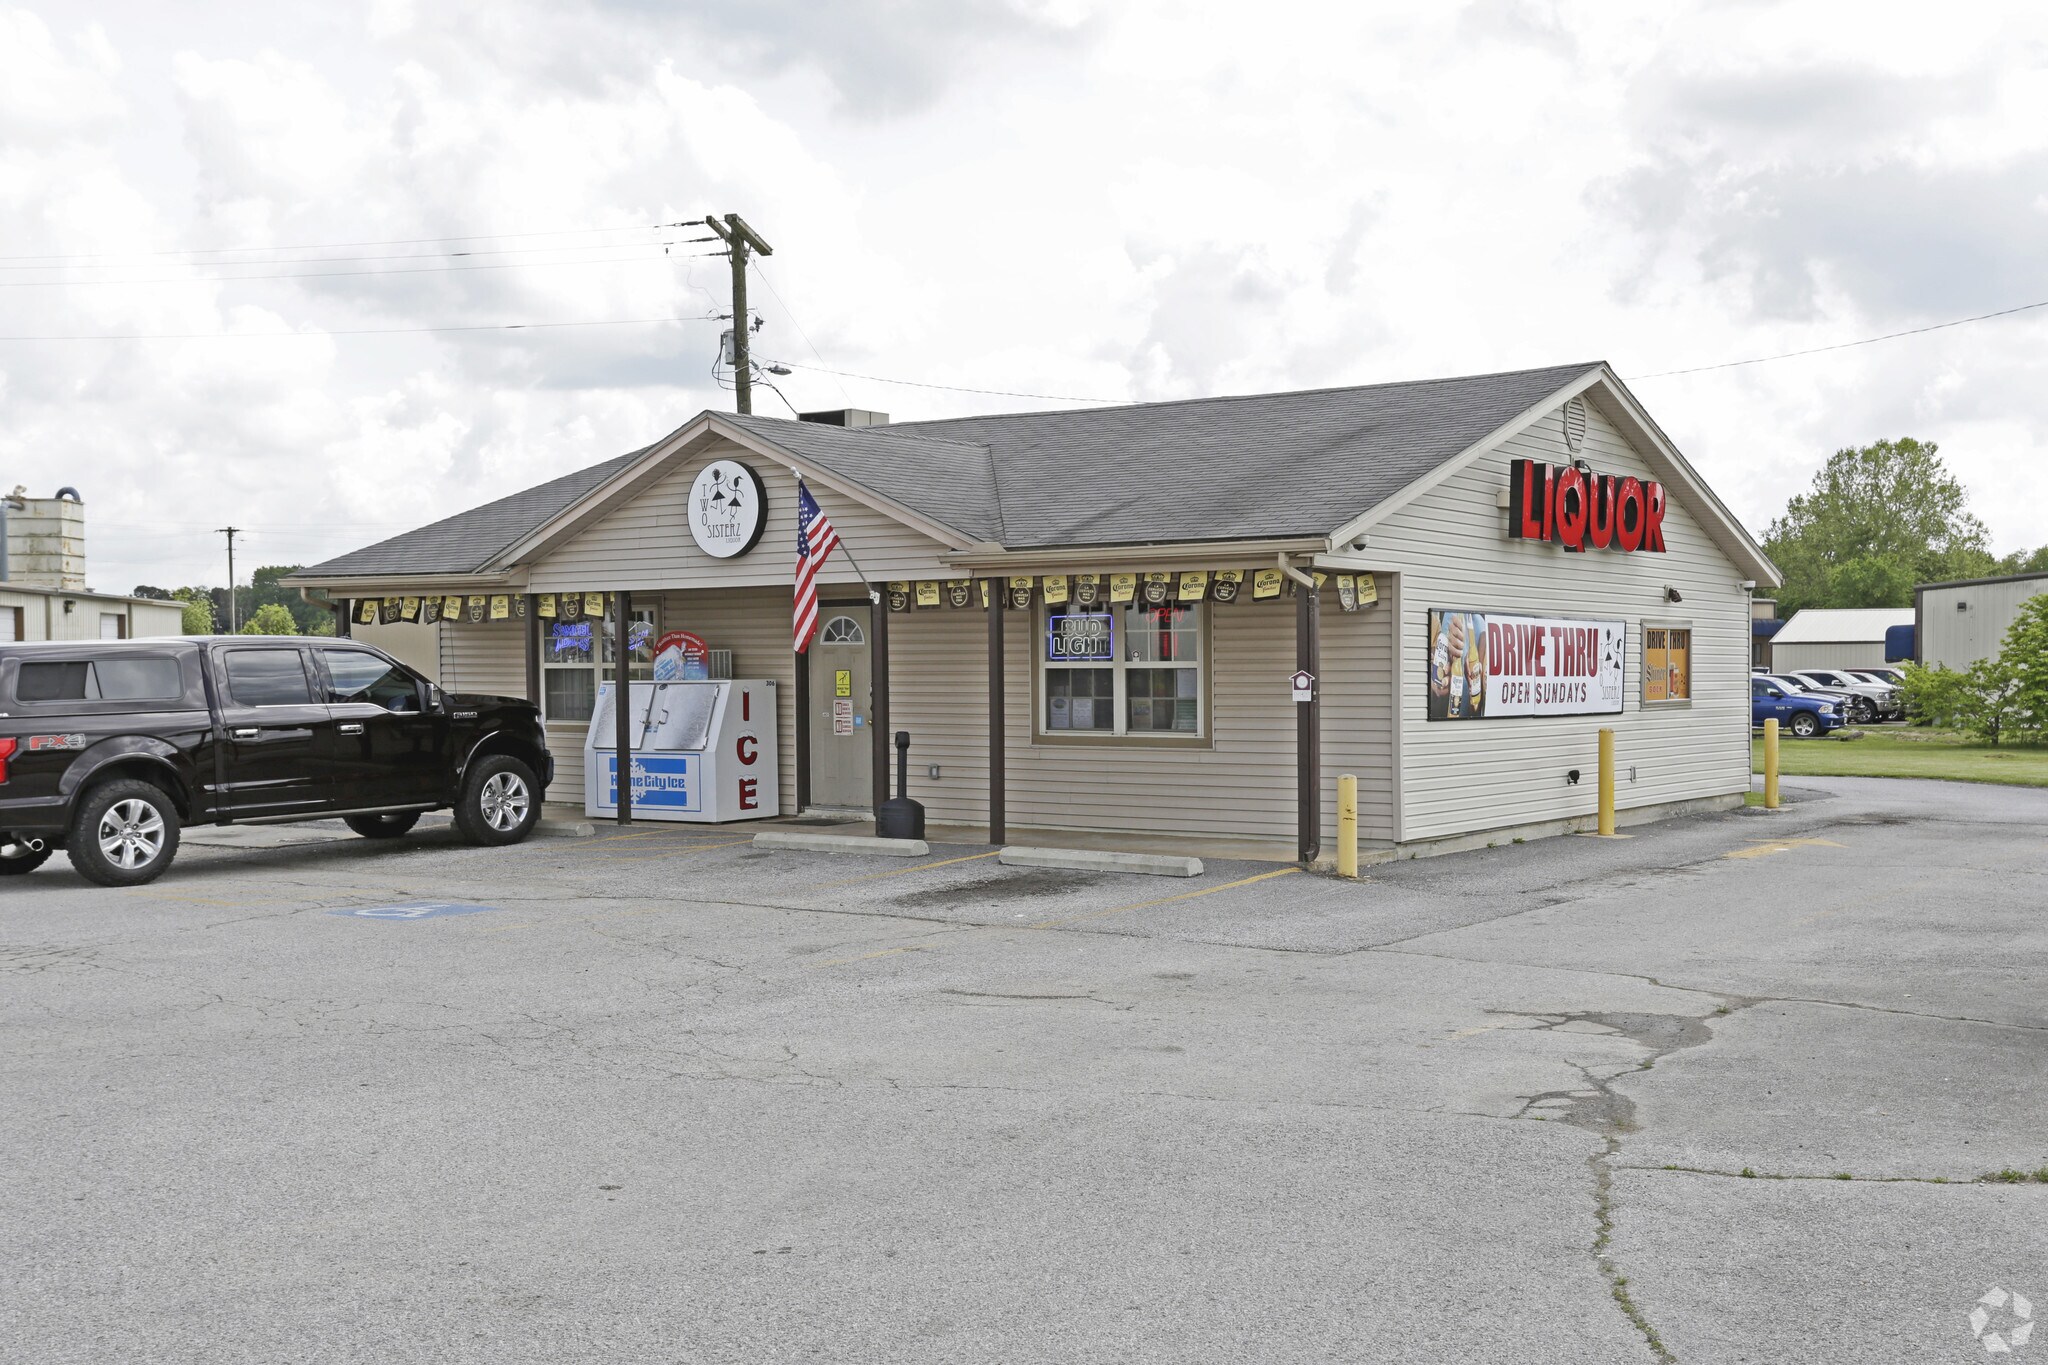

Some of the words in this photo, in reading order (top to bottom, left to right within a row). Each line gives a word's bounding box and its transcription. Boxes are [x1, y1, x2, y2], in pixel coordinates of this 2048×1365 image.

[1520, 459, 1667, 553] LIQUOR
[707, 523, 741, 538] SISTERZ
[1046, 585, 1066, 593] Corona
[1112, 583, 1134, 592] Corona
[1182, 582, 1204, 590] Corona
[1256, 579, 1280, 588] Corona
[1145, 608, 1185, 623] OPEN
[1061, 620, 1101, 637] BUD
[1053, 637, 1109, 655] LIGHT
[1647, 631, 1666, 649] DRIVE
[1670, 631, 1685, 650] THRU
[1488, 622, 1546, 677] DRIVE
[1550, 626, 1598, 677] THRU
[1502, 682, 1530, 704] OPEN
[1535, 682, 1587, 704] SUNDAYS
[29, 733, 86, 750] FX4
[736, 686, 758, 810] ICE
[610, 774, 643, 787] He
[644, 775, 666, 790] City
[668, 776, 685, 788] Ice
